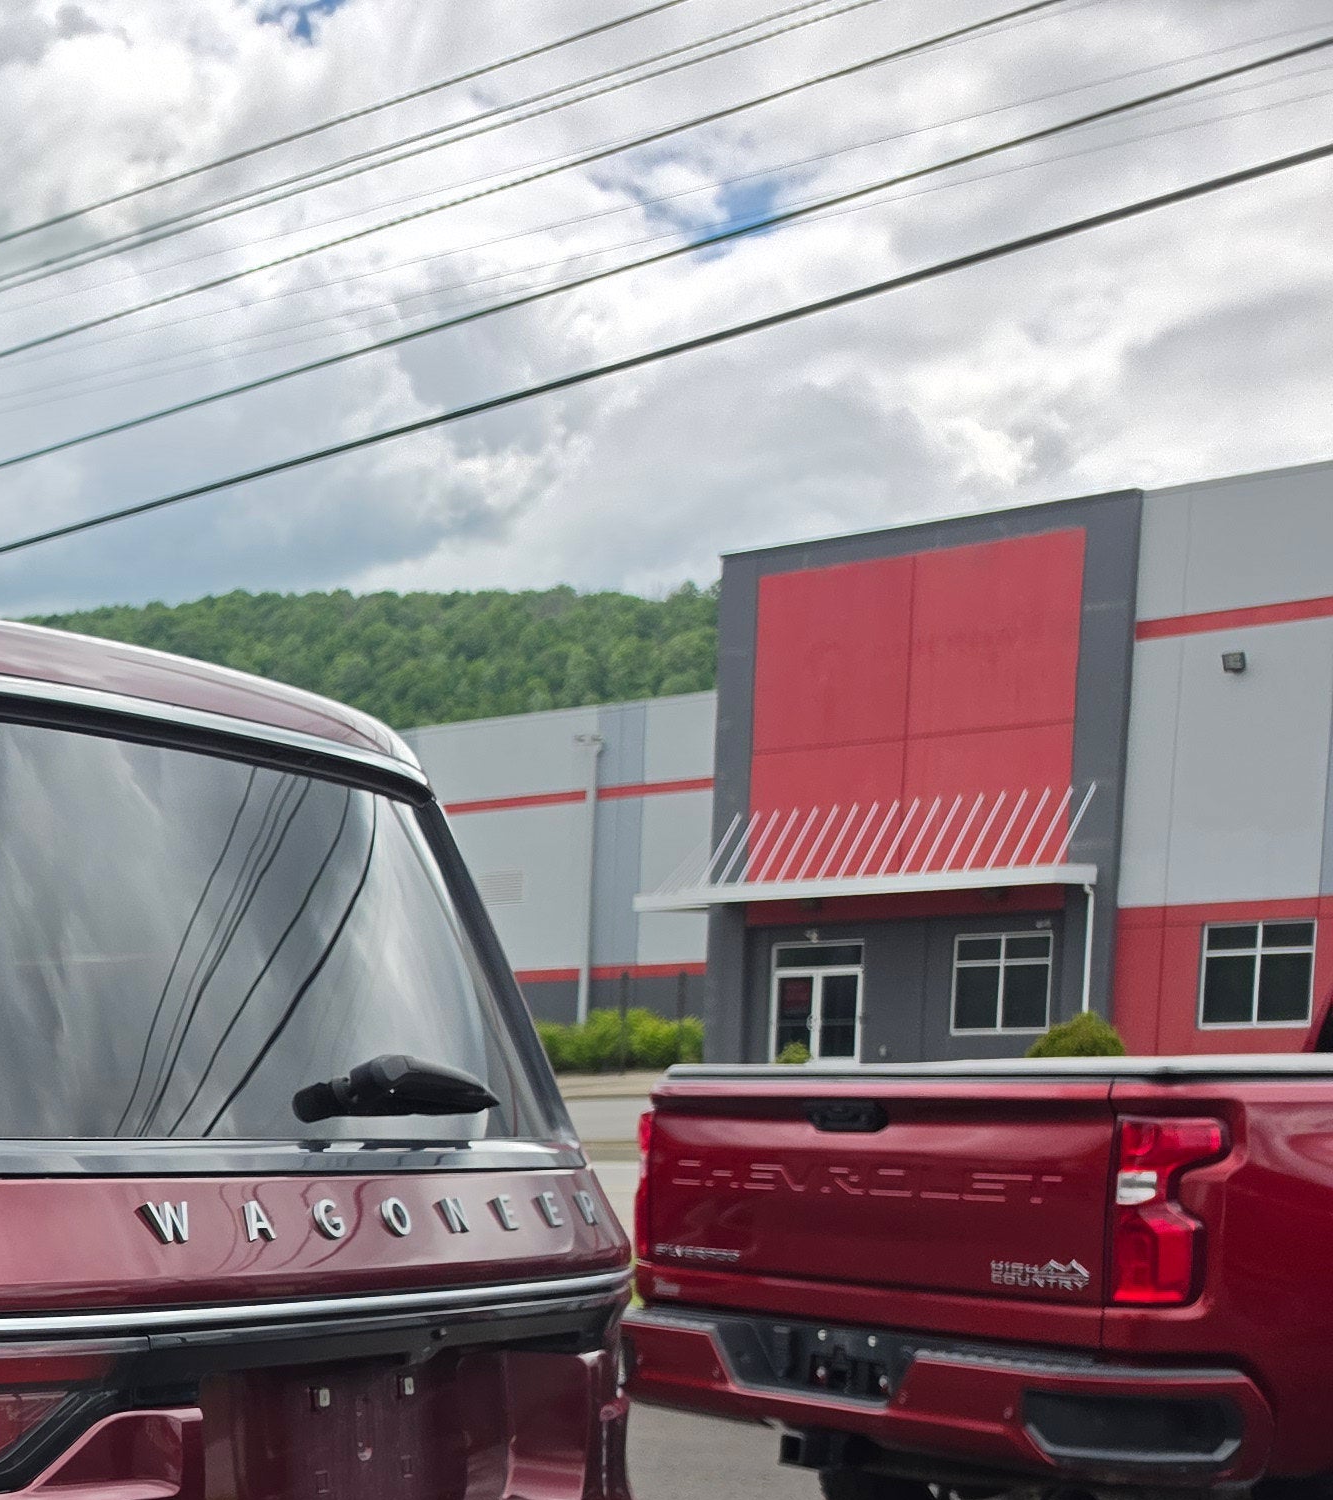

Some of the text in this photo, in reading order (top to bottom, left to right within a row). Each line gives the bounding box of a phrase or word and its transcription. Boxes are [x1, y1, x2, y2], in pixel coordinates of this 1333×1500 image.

[671, 1159, 1064, 1204] CHEVROLET
[137, 1190, 599, 1244] WAGONEER
[990, 1271, 1089, 1290] COUNTRY
